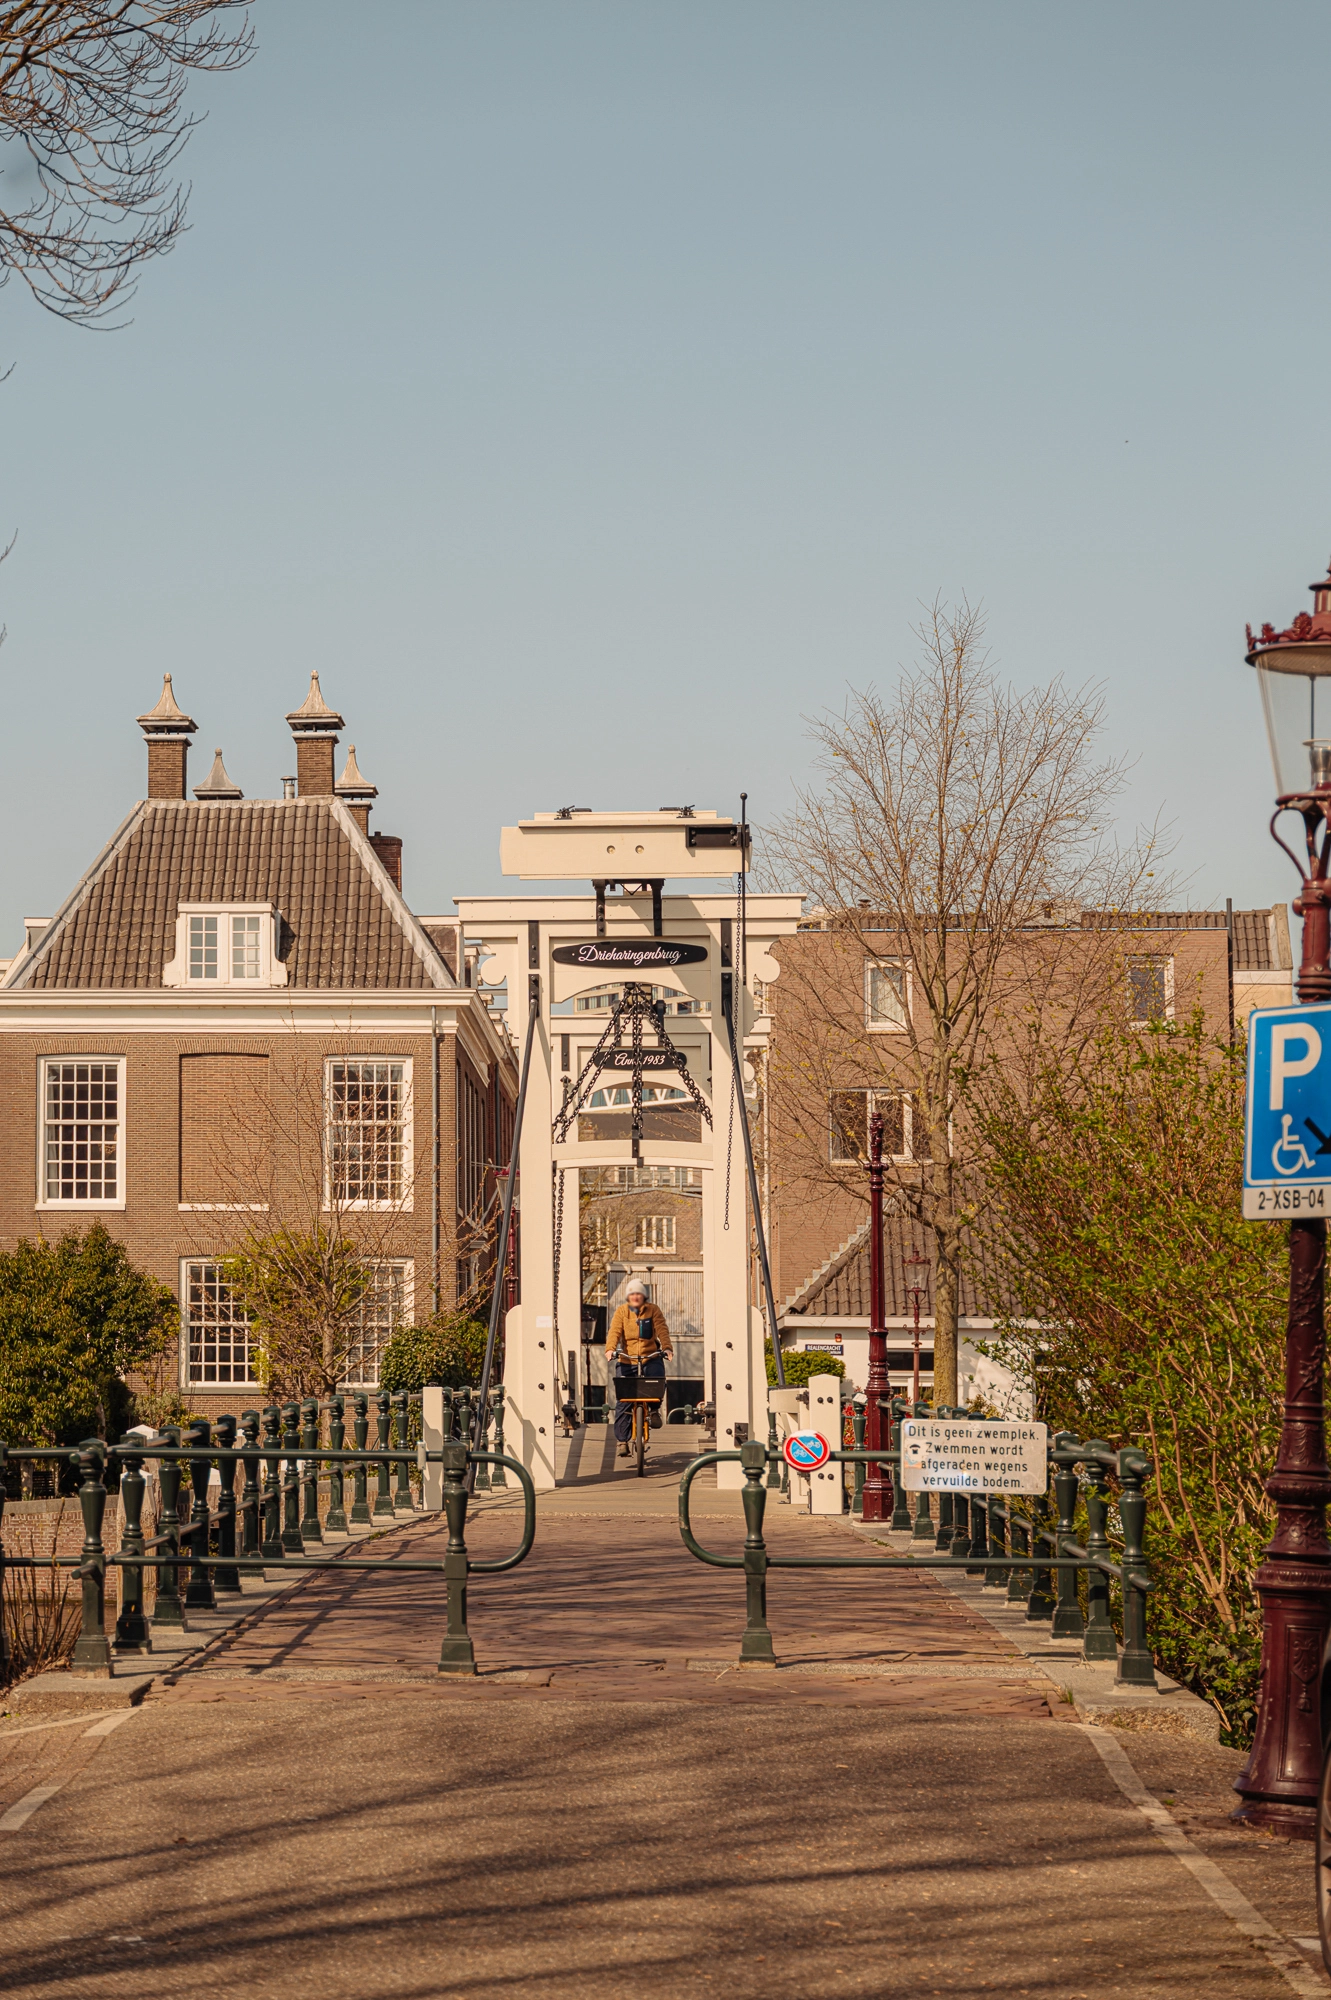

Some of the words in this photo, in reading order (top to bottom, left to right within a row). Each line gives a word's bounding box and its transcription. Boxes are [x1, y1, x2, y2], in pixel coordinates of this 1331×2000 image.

[578, 945, 681, 965] Drieharingenbrug
[614, 1052, 639, 1066] Ann
[642, 1055, 665, 1065] 1983
[1269, 1022, 1322, 1110] P
[1258, 1188, 1324, 1211] 2-XSB-04
[908, 1426, 926, 1437] Dit
[930, 1426, 940, 1437] is
[944, 1429, 972, 1440] geen
[976, 1429, 1039, 1441] zwemplek.
[925, 1442, 986, 1455] Zwemmen
[990, 1445, 1024, 1456] wordt
[921, 1459, 980, 1472] afgeraden
[984, 1462, 1028, 1474] wegens
[922, 1475, 978, 1487] vervuilde
[982, 1476, 1024, 1488] bodem.
